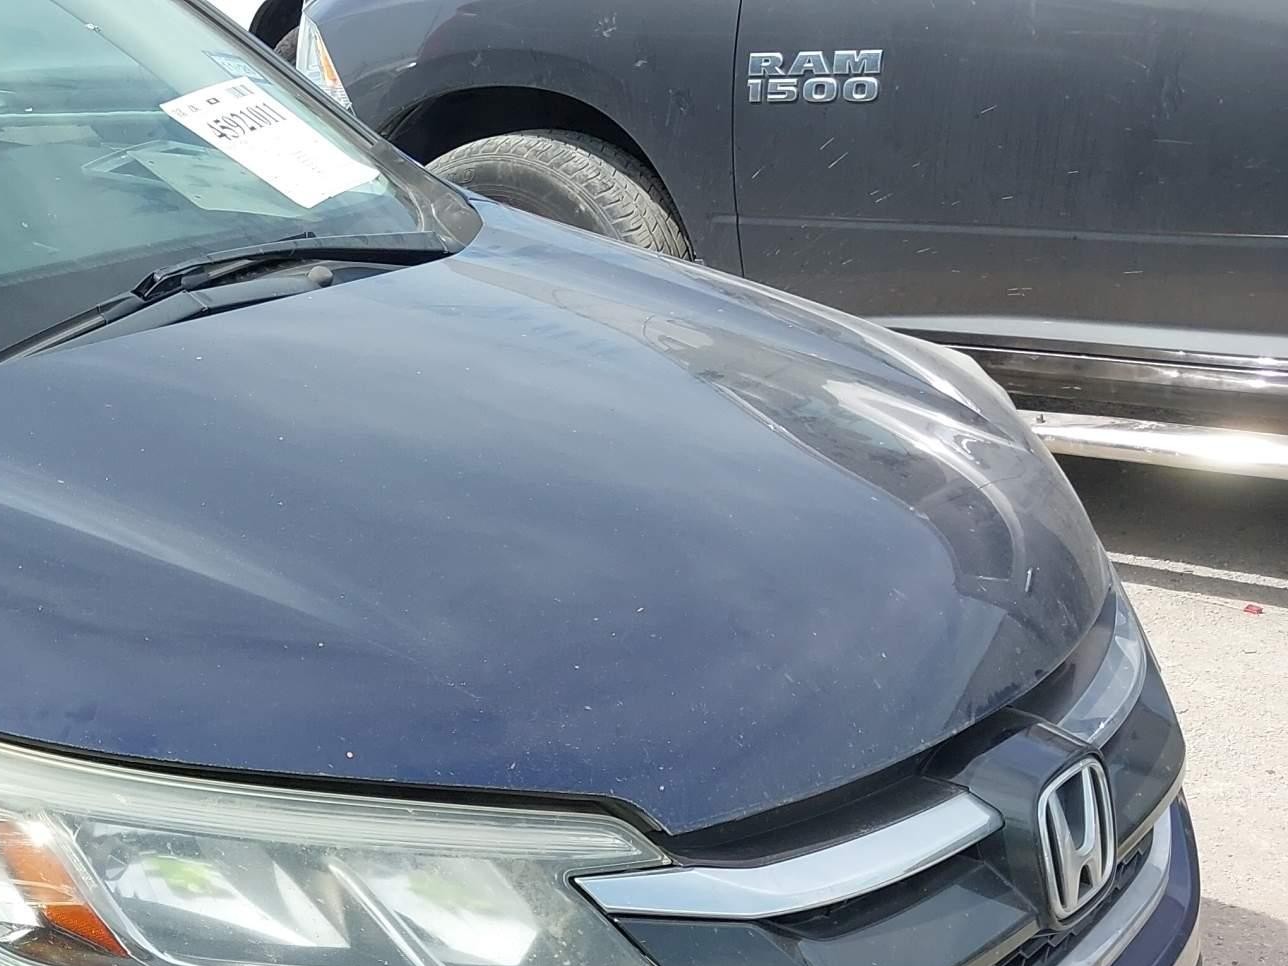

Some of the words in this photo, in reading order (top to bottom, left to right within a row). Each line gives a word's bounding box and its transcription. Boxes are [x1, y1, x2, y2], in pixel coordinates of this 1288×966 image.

[748, 49, 883, 76] RAM
[747, 77, 879, 103] 1500
[205, 102, 288, 141] 45921011
